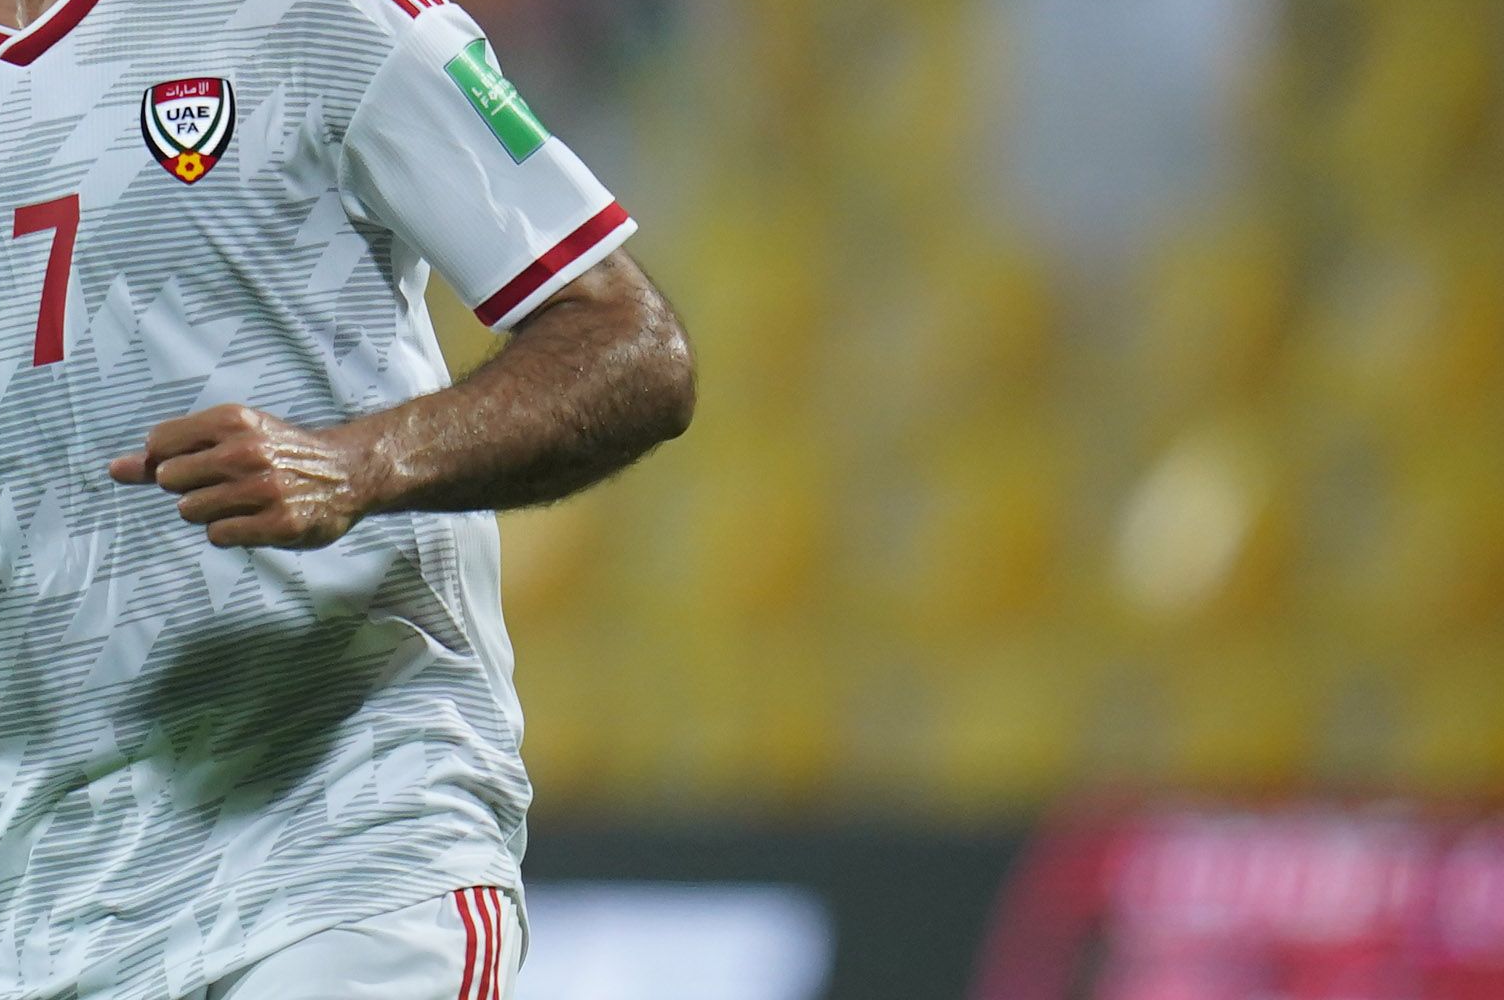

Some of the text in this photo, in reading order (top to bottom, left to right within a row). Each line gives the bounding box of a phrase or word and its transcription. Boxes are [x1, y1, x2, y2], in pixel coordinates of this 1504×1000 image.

[166, 105, 210, 121] UAE
[177, 122, 199, 135] FA
[12, 193, 80, 367] 7
